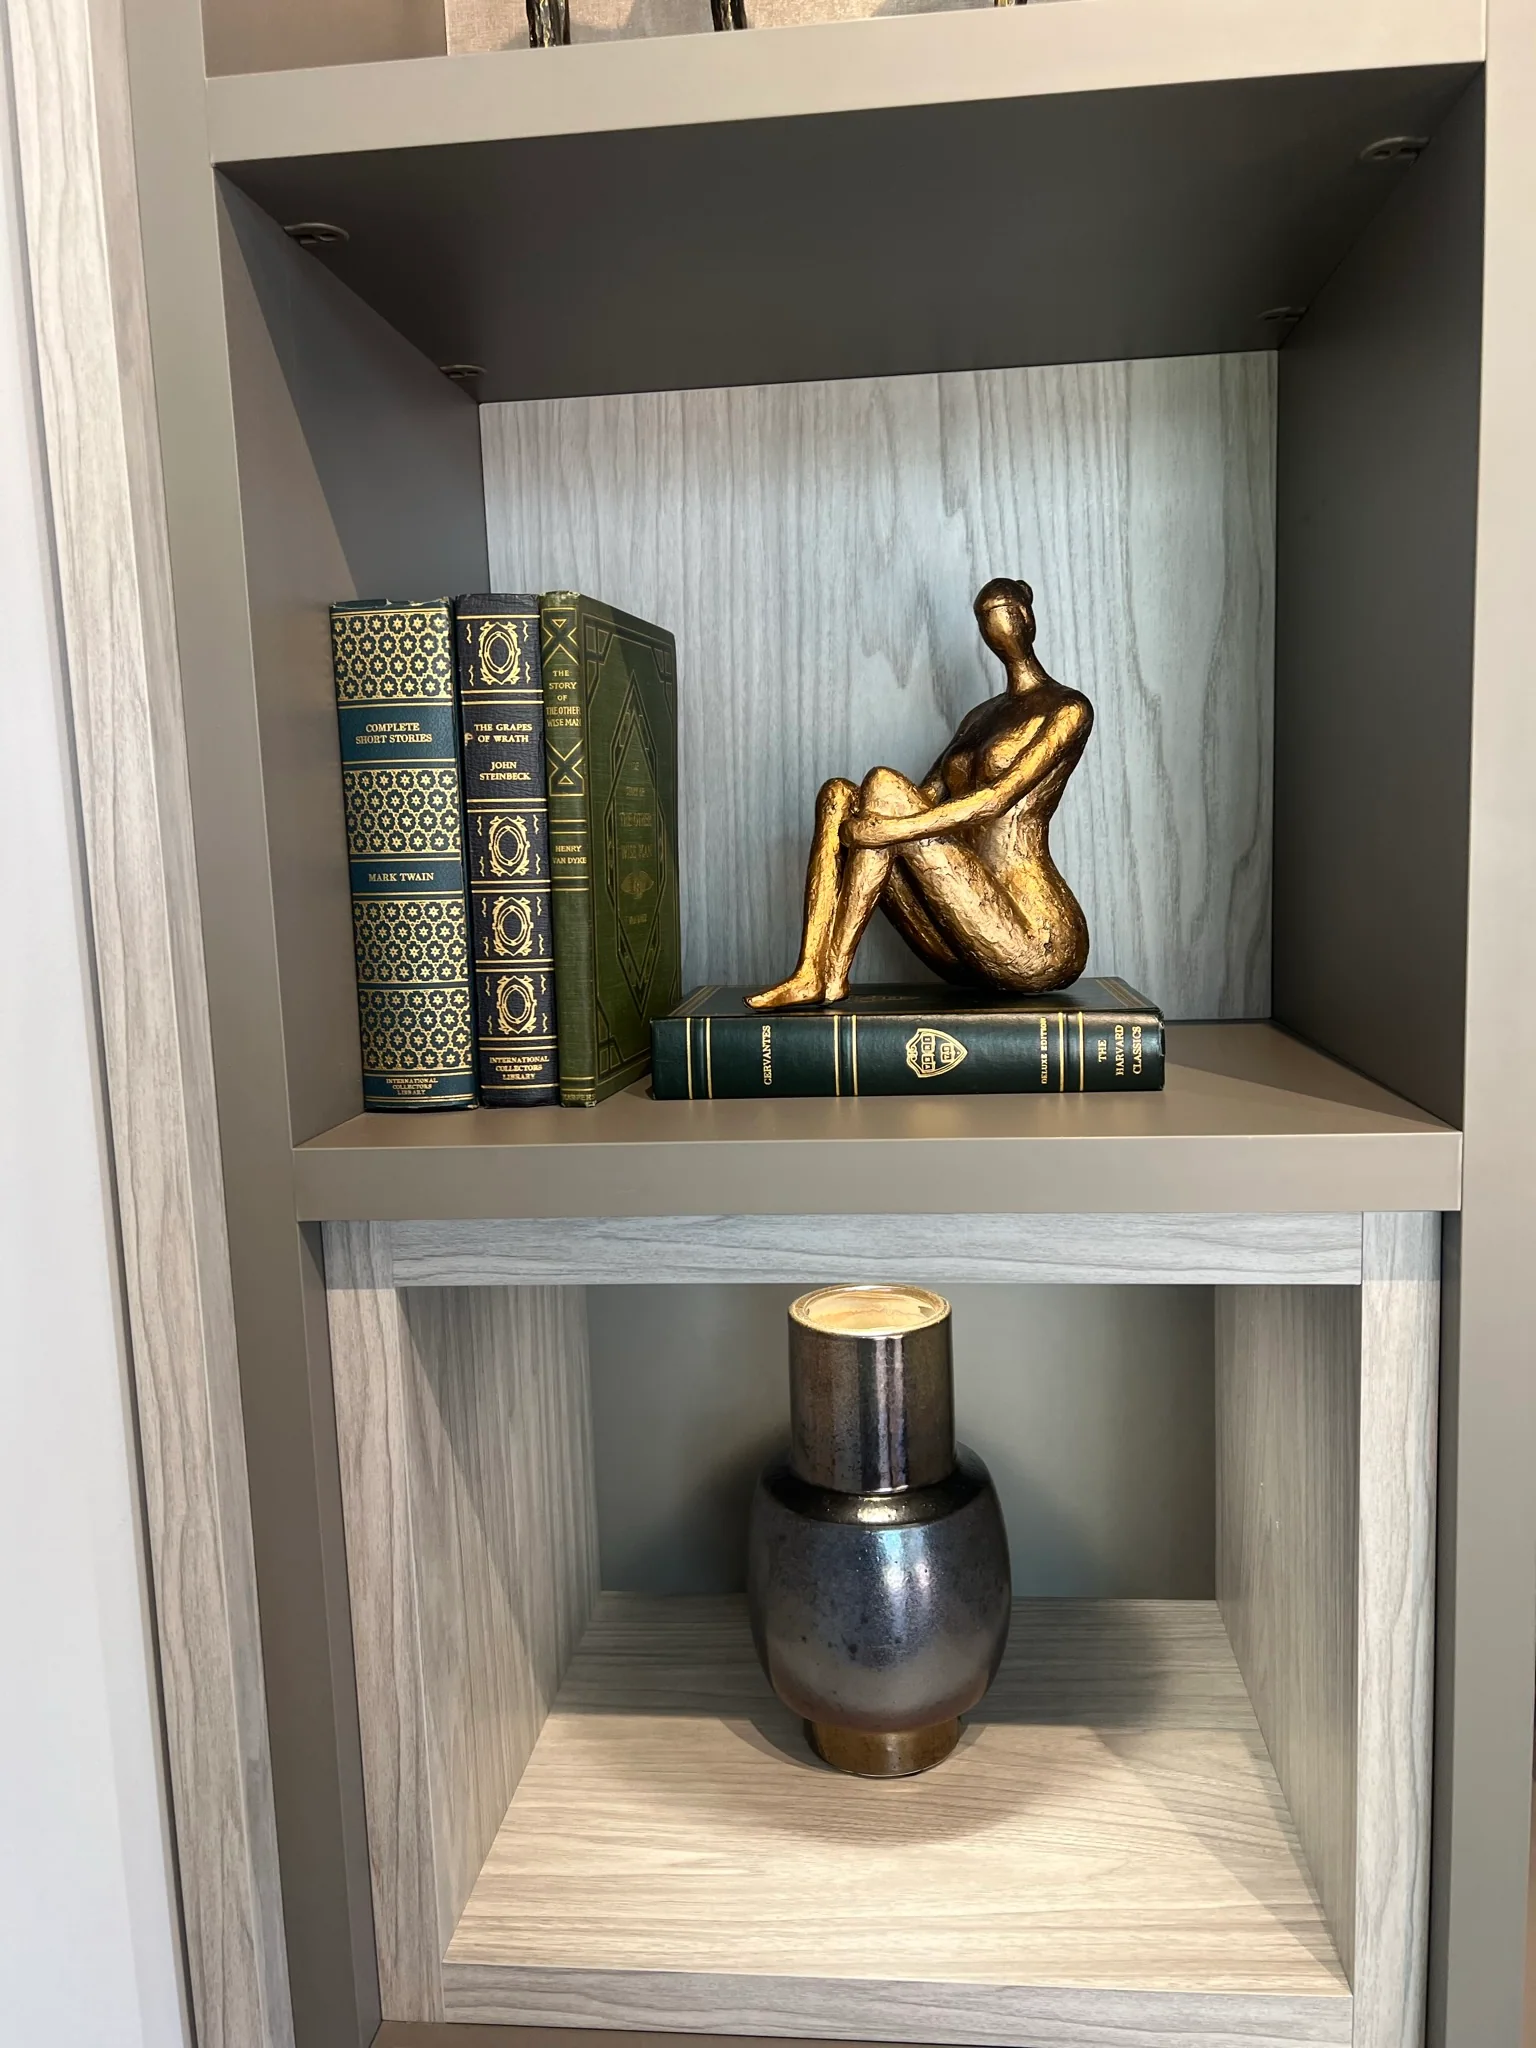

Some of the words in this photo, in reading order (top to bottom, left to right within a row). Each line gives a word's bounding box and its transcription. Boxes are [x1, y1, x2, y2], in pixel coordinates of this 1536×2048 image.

[549, 682, 577, 690] STORY
[546, 706, 559, 715] THE
[558, 706, 581, 715] OTHER
[547, 719, 564, 727] WISE
[565, 718, 582, 727] MAN
[365, 722, 420, 733] COMPLETE
[473, 723, 493, 731] THE
[495, 723, 533, 732] GRAPES
[355, 734, 387, 745] SHORT
[389, 733, 433, 743] STORIES
[477, 735, 490, 743] OF
[493, 734, 529, 743] WRATH
[490, 761, 517, 771] JOHN
[479, 772, 532, 781] STEINBECK
[555, 845, 582, 853] HENRY
[552, 856, 566, 865] VAN
[567, 856, 587, 865] DYKE
[368, 873, 397, 882] MARK
[399, 872, 434, 881] TWAIN
[1098, 1039, 1107, 1063] THE
[1115, 1024, 1124, 1076] HARVARD
[1132, 1025, 1142, 1075] CLASSICS
[489, 1055, 550, 1064] INTERNATIONAL
[762, 1025, 772, 1085] CERVANTES
[495, 1064, 543, 1072] COLLECTORS
[502, 1073, 536, 1081] LIBRARY
